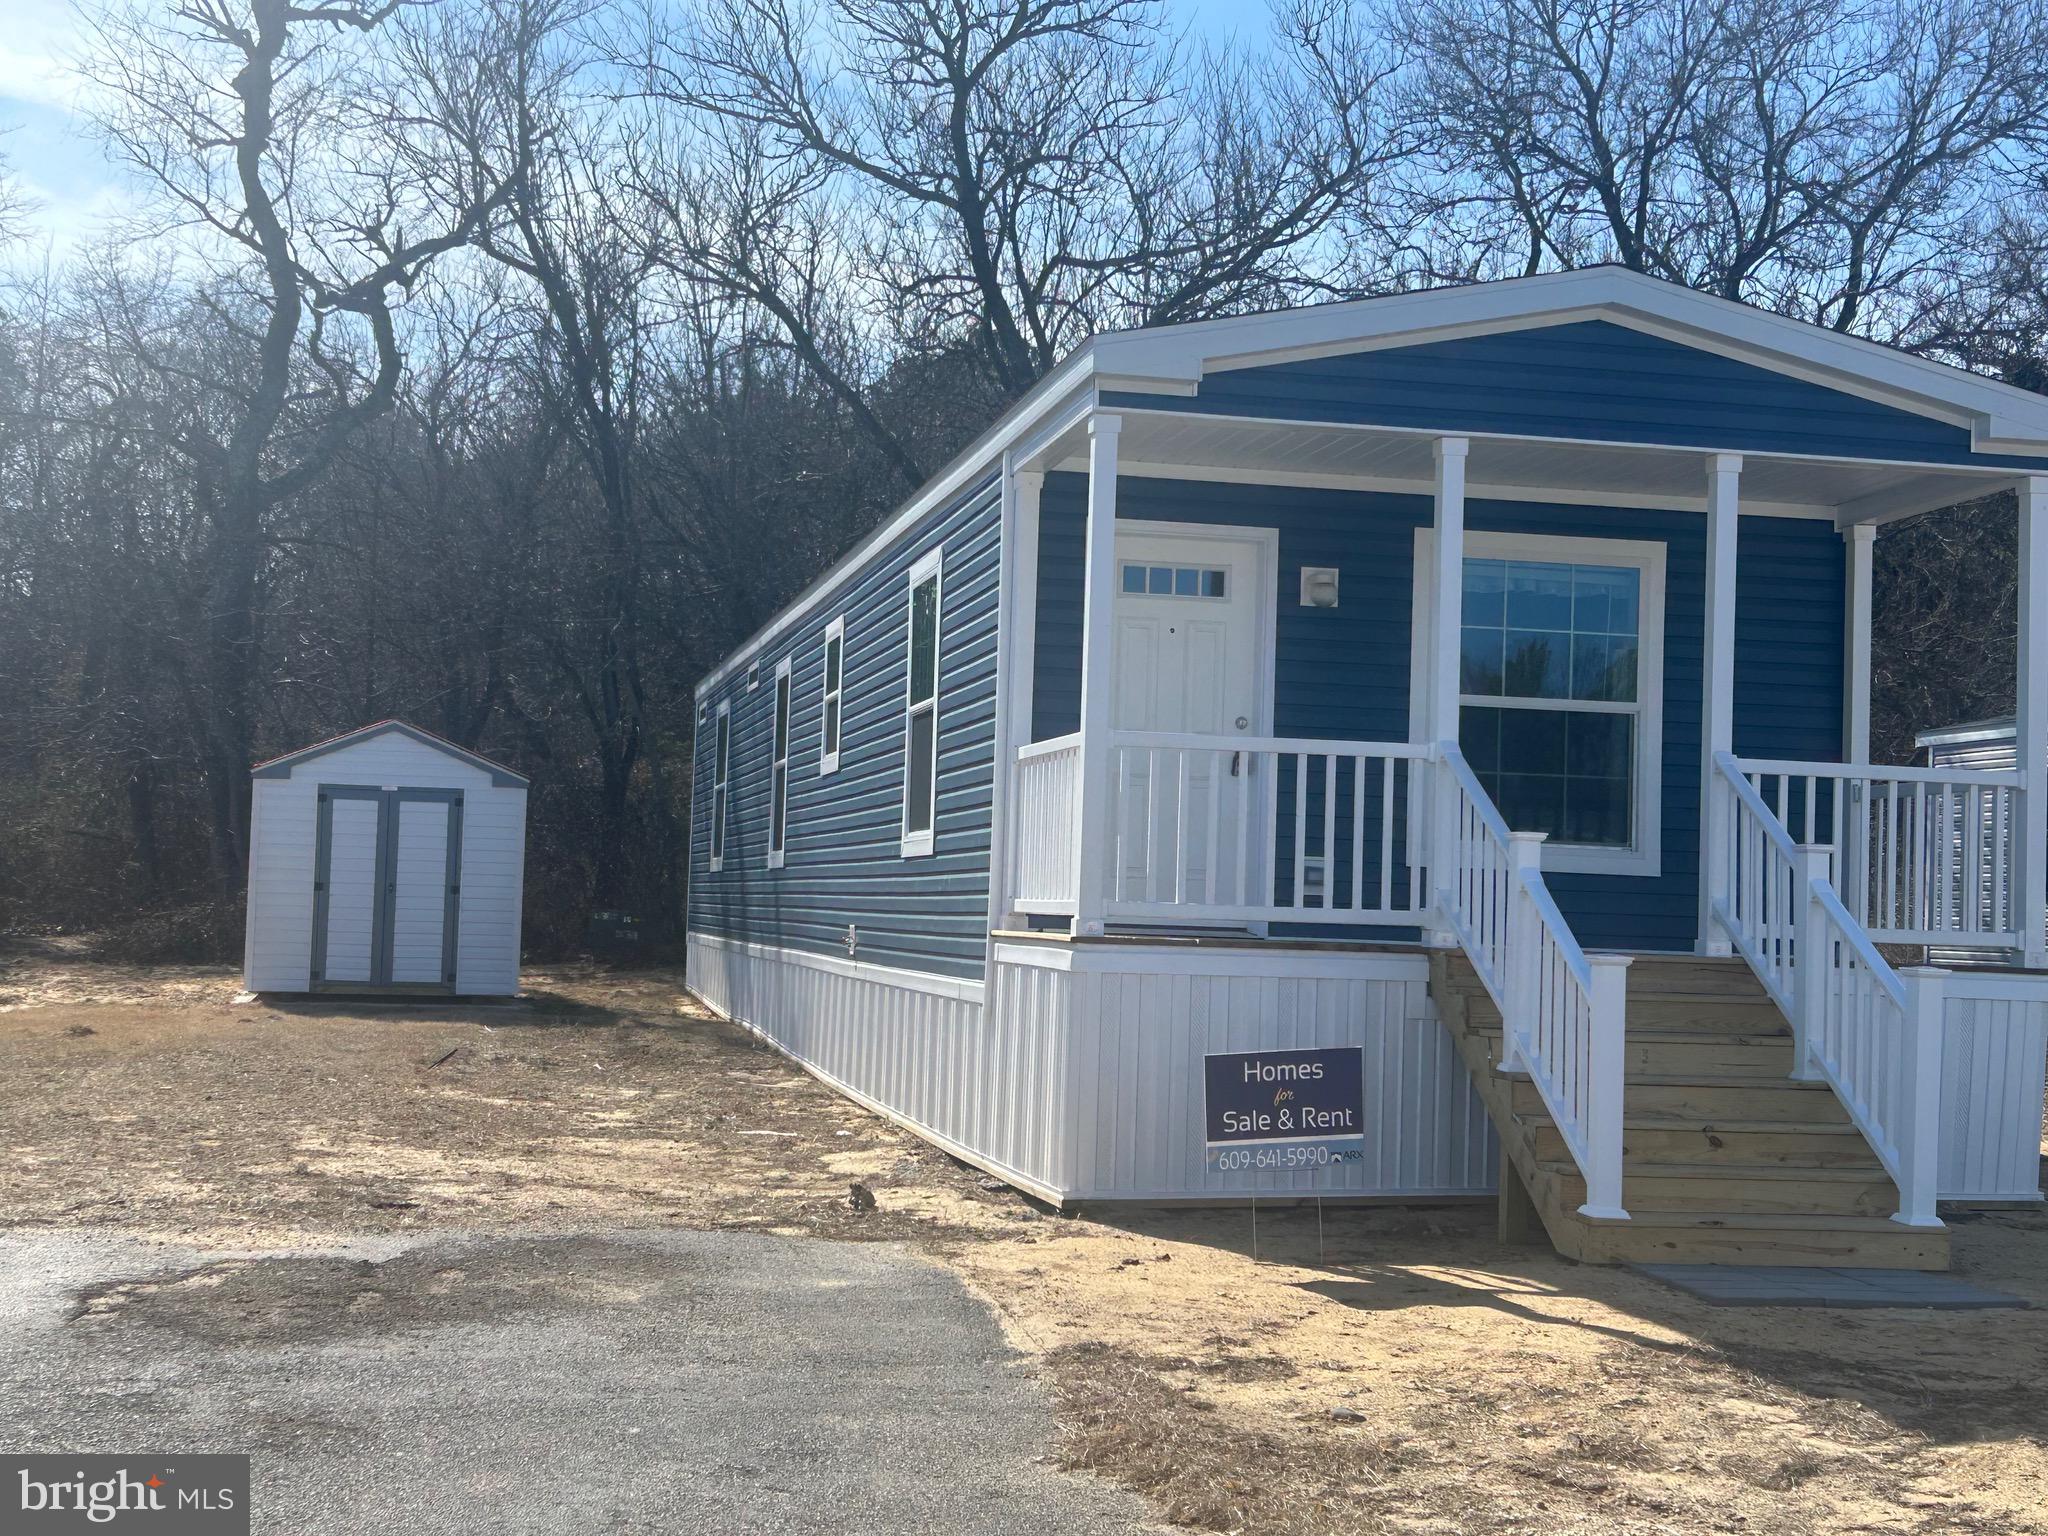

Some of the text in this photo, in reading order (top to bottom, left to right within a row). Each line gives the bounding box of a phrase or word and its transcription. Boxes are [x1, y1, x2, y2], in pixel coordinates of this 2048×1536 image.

[1244, 1060, 1323, 1083] Homes
[1274, 1087, 1295, 1106] for
[1223, 1107, 1352, 1133] Sale & Rent
[1219, 1146, 1328, 1170] 609-641-5990
[1343, 1151, 1364, 1160] ARX
